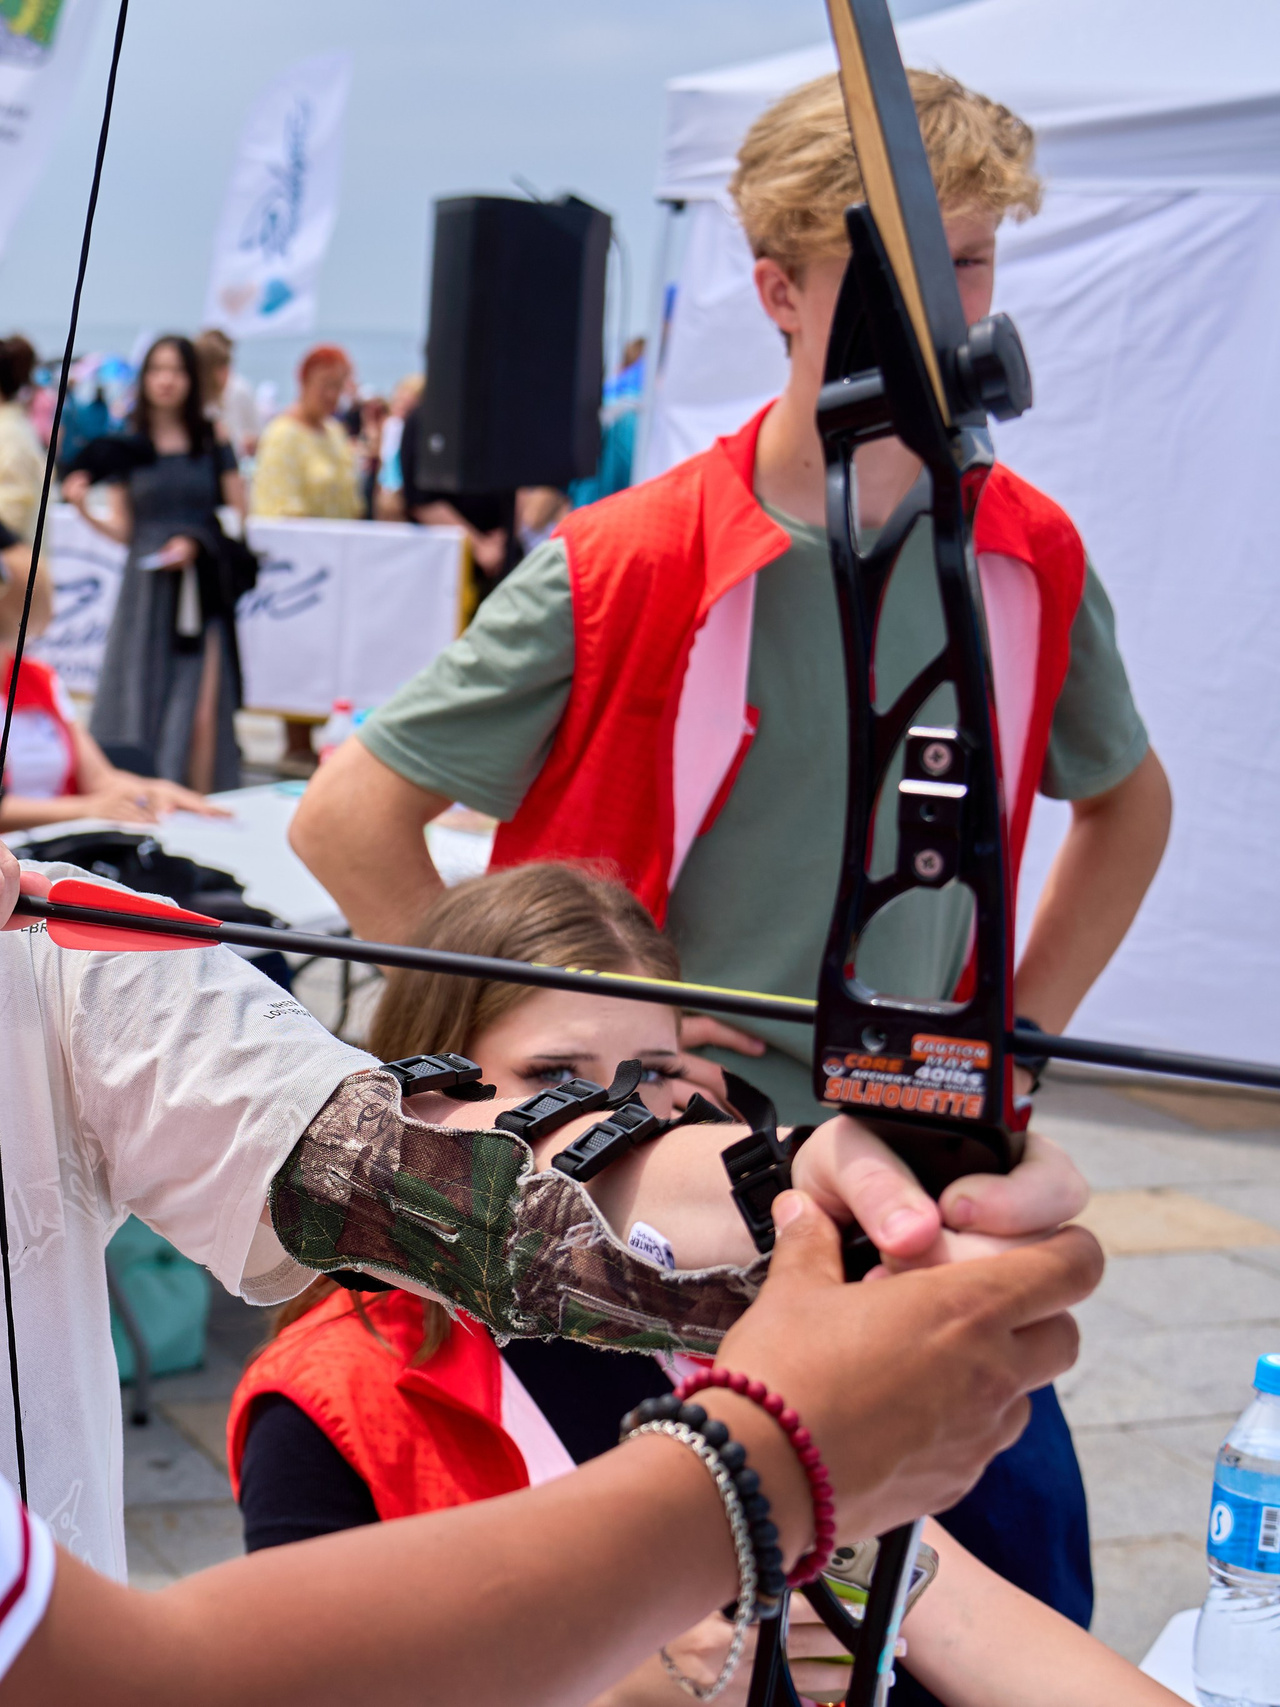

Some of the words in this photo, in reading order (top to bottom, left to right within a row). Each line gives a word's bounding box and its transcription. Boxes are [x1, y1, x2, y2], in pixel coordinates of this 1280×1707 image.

[913, 1040, 986, 1059] CAUTION
[845, 1054, 903, 1073] CORE
[925, 1055, 972, 1071] MAX
[850, 1069, 912, 1084] ARCHERY
[824, 1076, 984, 1119] SILHOUETTE
